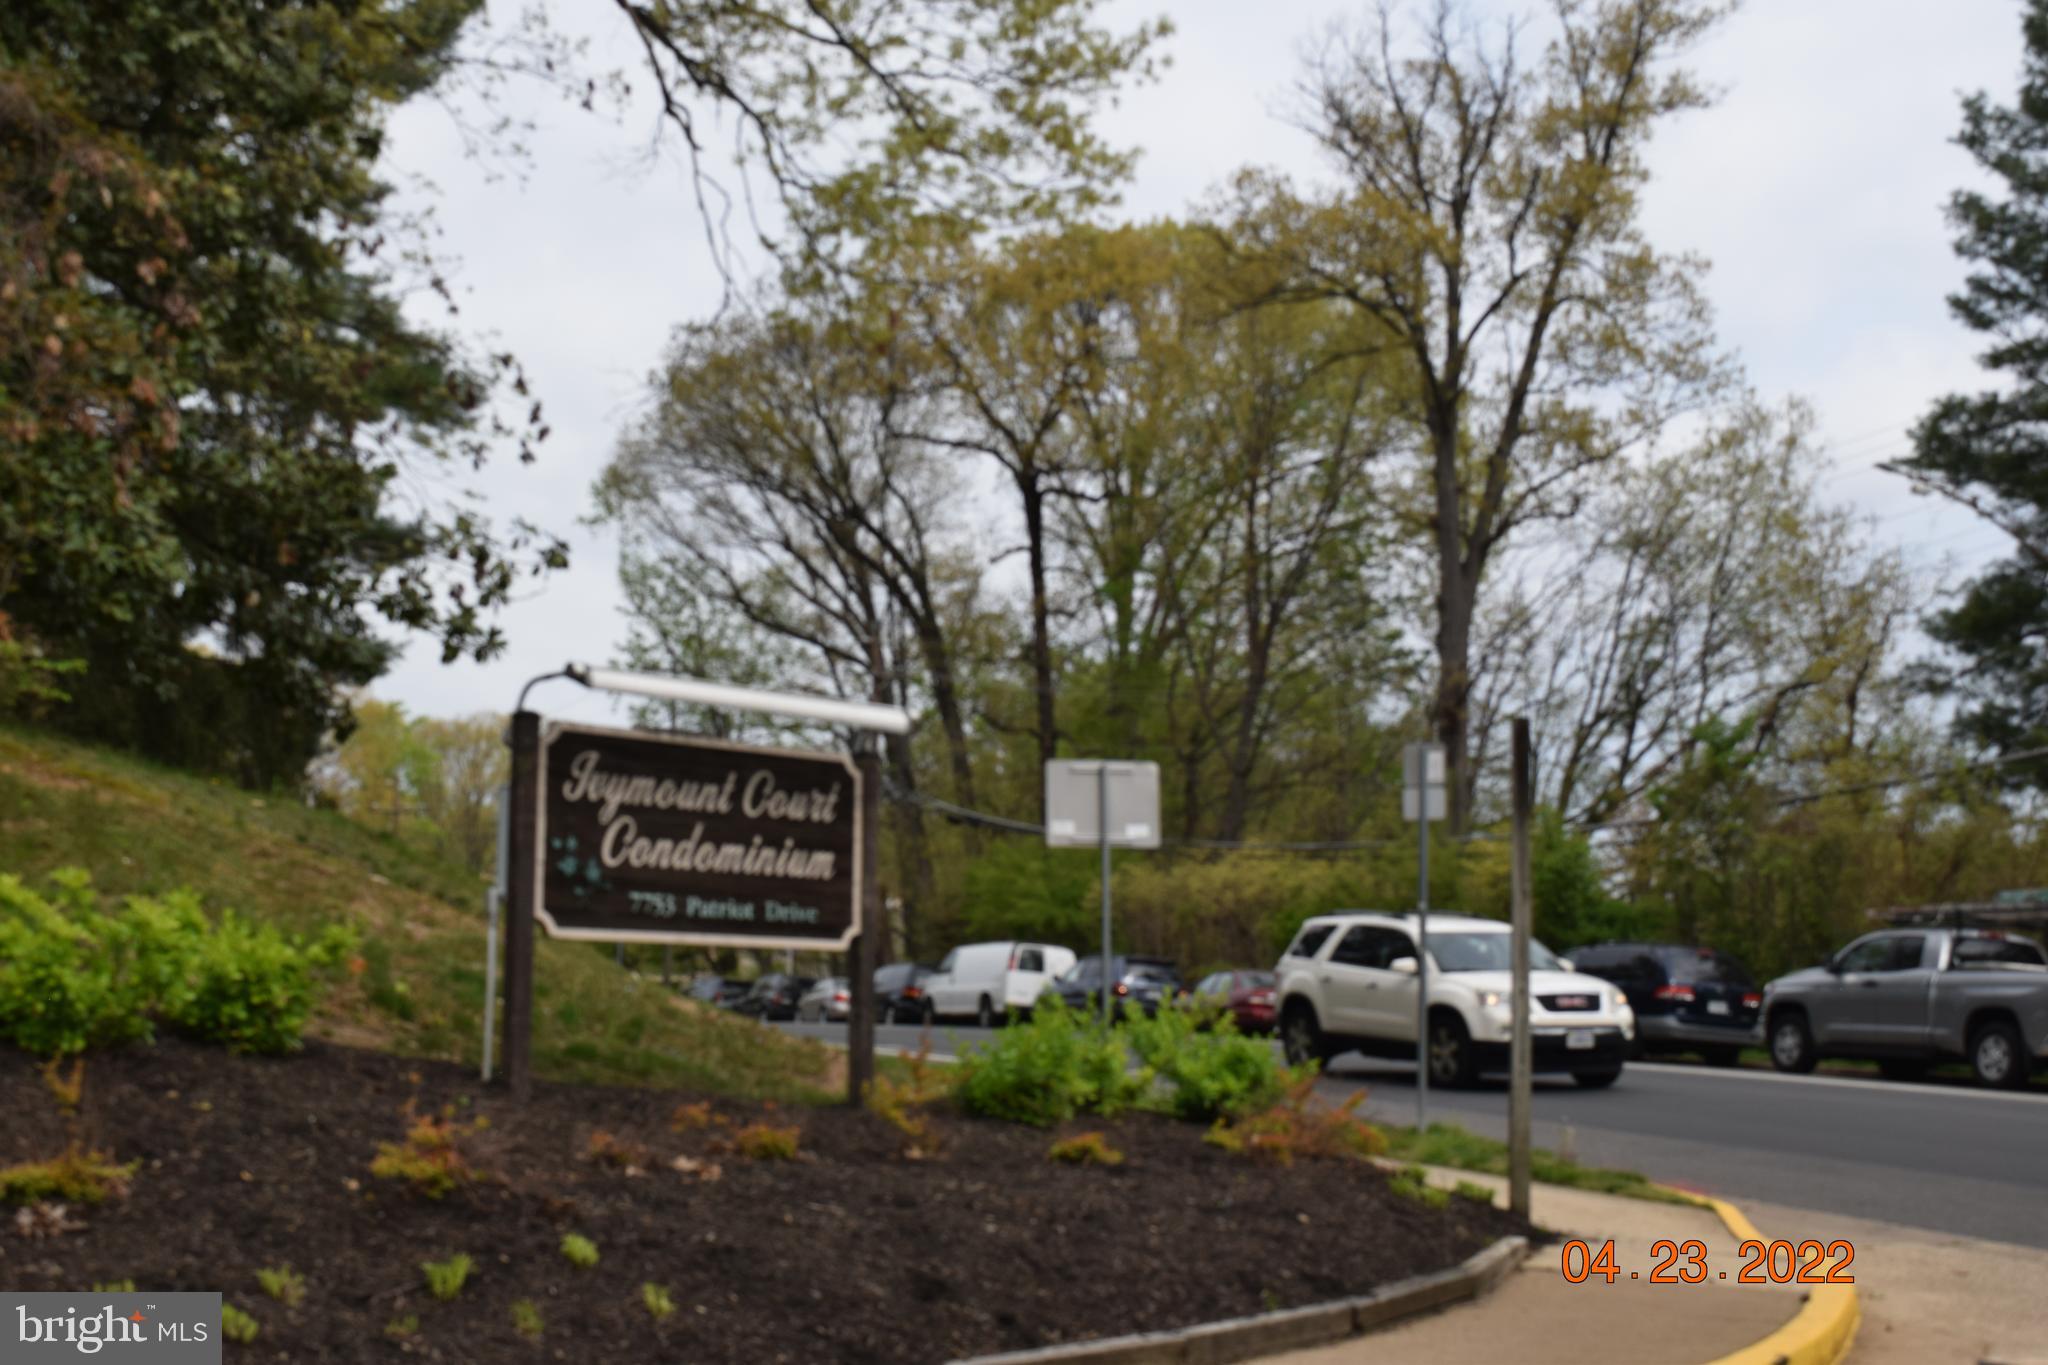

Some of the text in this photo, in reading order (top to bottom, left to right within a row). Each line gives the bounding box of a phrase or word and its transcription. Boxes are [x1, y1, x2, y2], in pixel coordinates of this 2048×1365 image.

[562, 750, 842, 826] Ivymount Court
[601, 815, 836, 881] Condominium
[686, 896, 754, 920] Patriot
[765, 900, 819, 922] Drive
